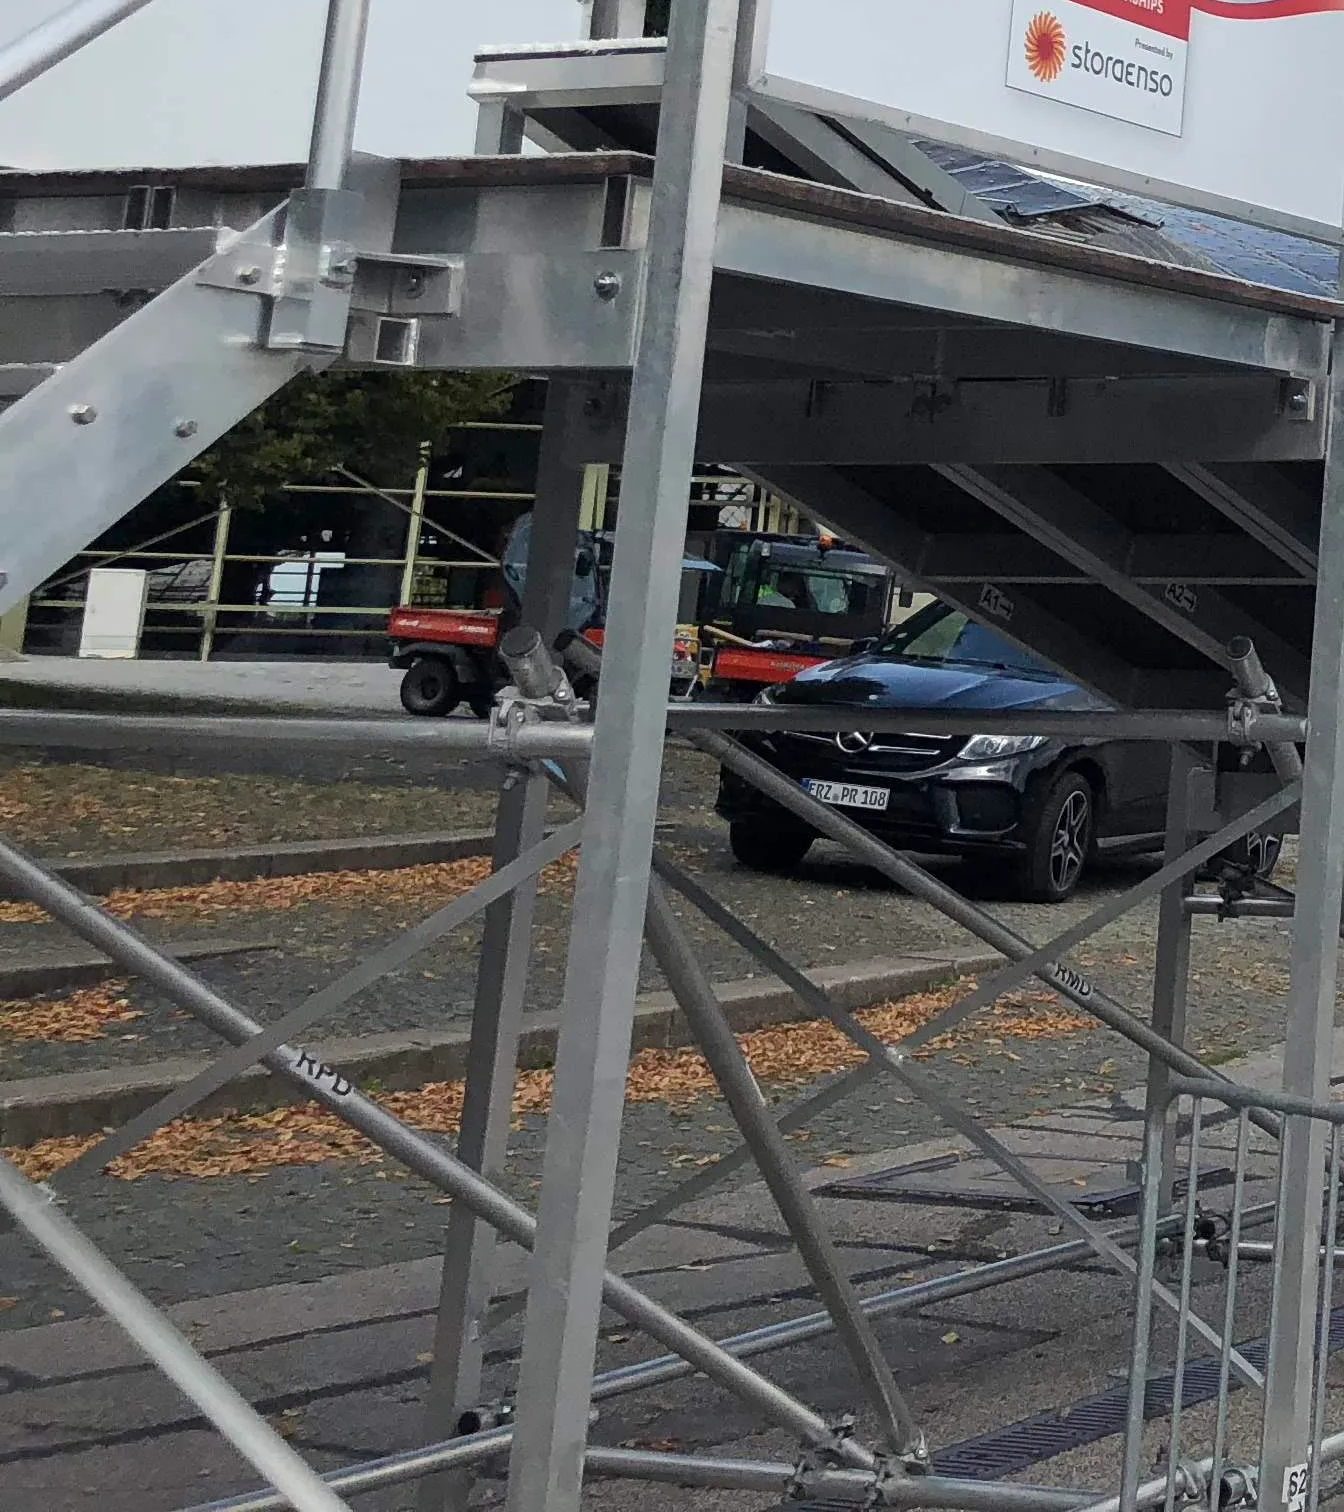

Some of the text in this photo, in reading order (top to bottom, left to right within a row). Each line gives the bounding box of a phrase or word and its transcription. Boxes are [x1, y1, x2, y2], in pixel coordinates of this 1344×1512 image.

[1135, 38, 1174, 60] Presented by
[1071, 41, 1173, 96] storaenso
[982, 589, 999, 610] A1
[1167, 584, 1184, 602] A2
[808, 782, 886, 806] ERZ PR 108
